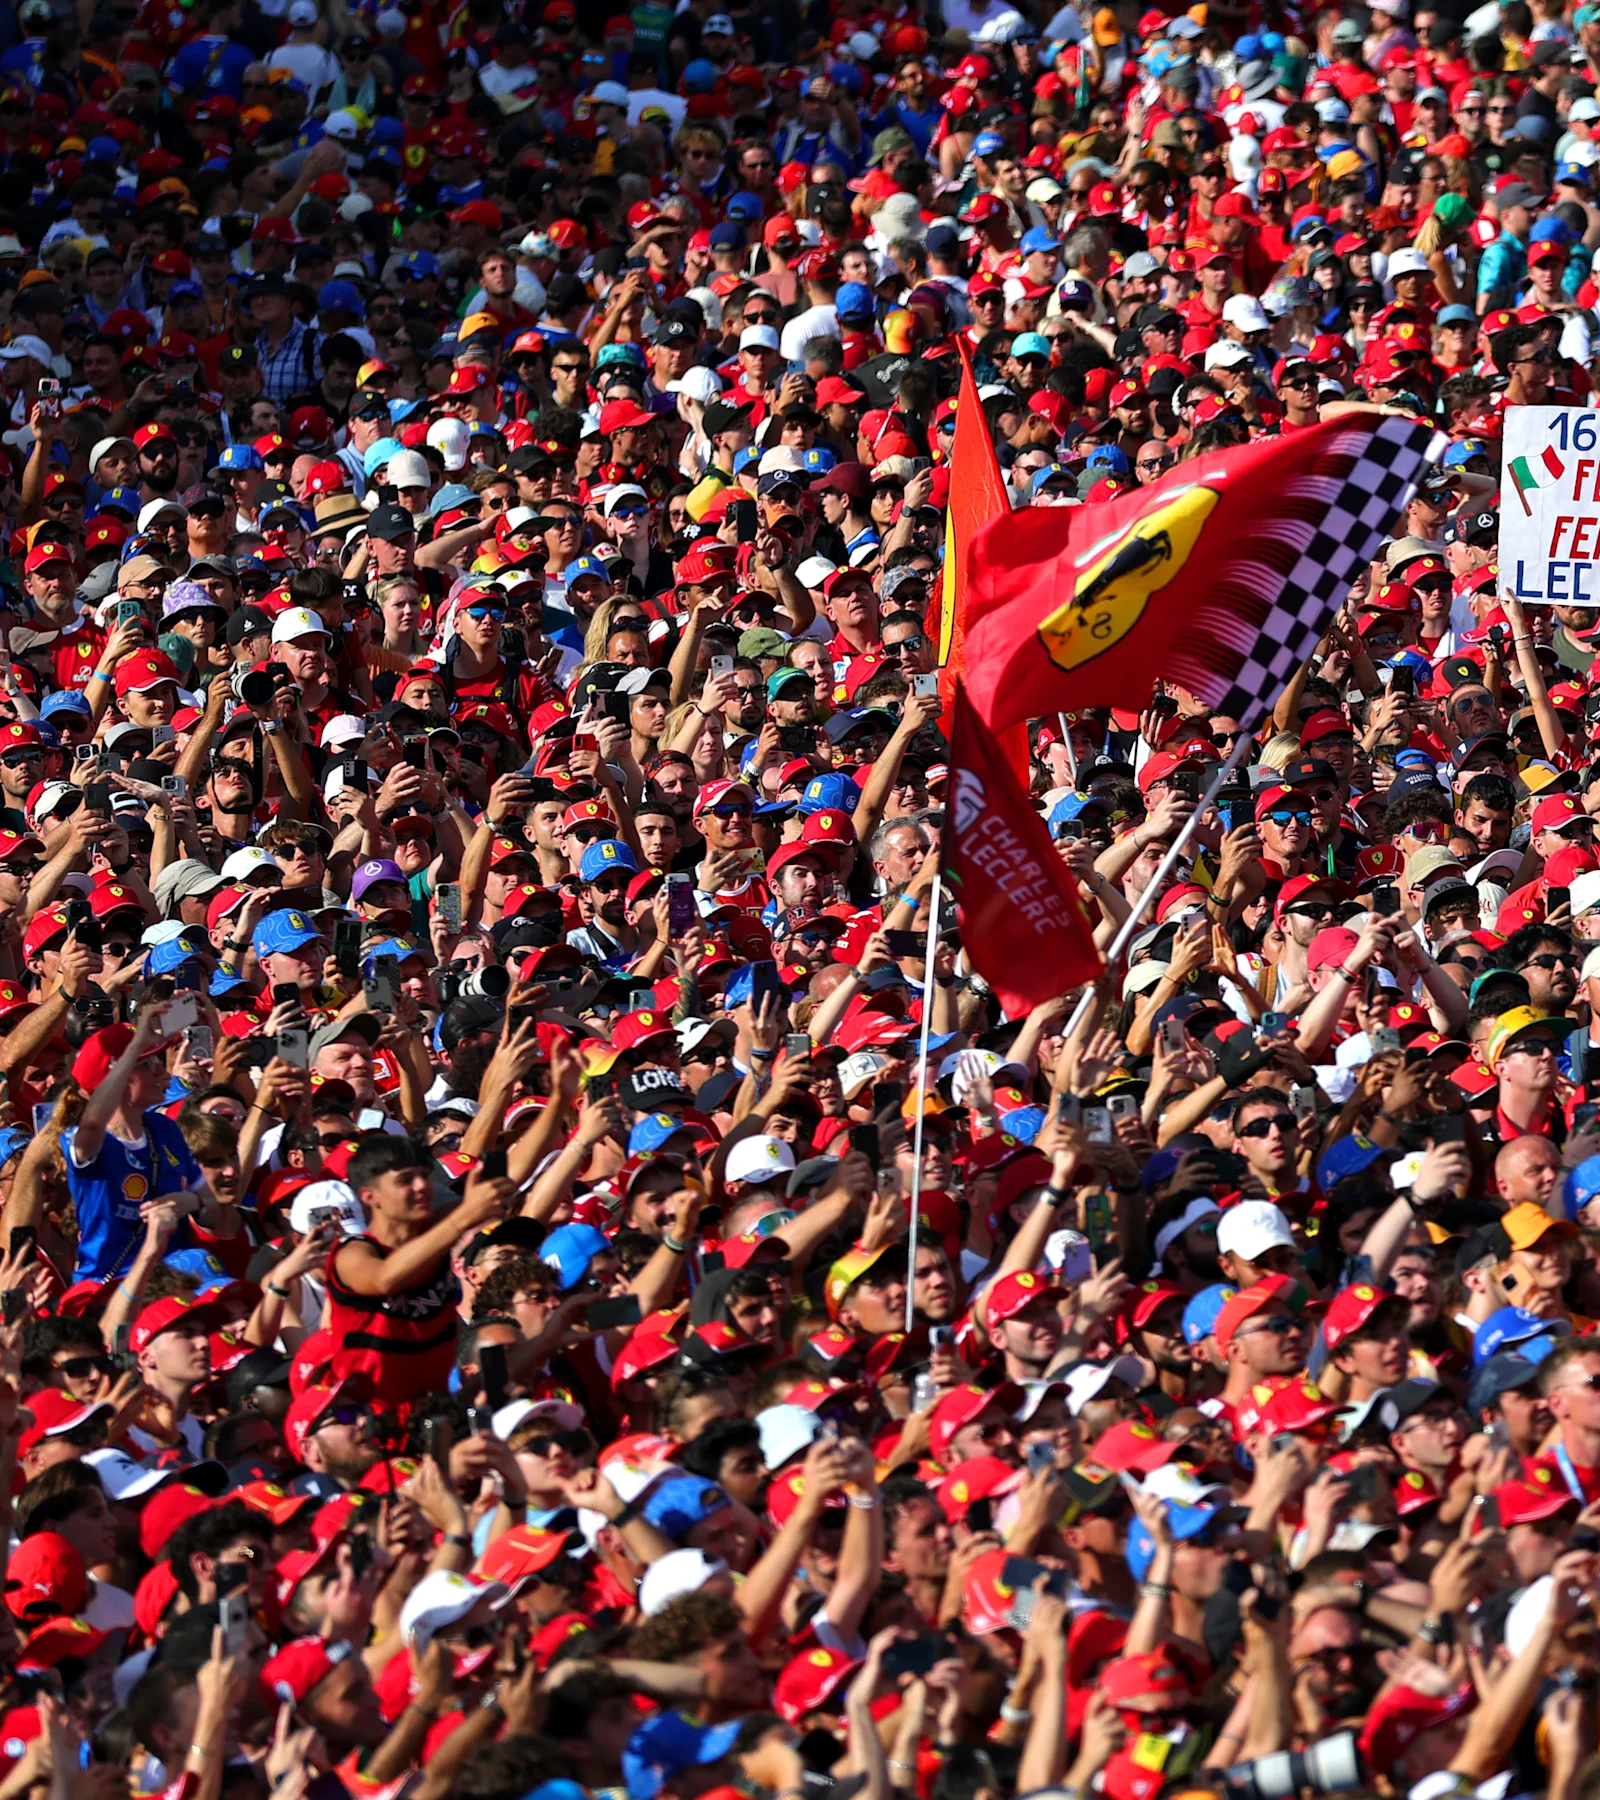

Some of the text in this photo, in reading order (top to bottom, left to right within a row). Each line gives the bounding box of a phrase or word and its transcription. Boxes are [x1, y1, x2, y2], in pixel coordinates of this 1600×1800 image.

[1548, 412, 1597, 451] 16
[1515, 560, 1593, 601] LEC
[961, 832, 1057, 934] LECLERC
[981, 815, 1074, 928] CHARLES
